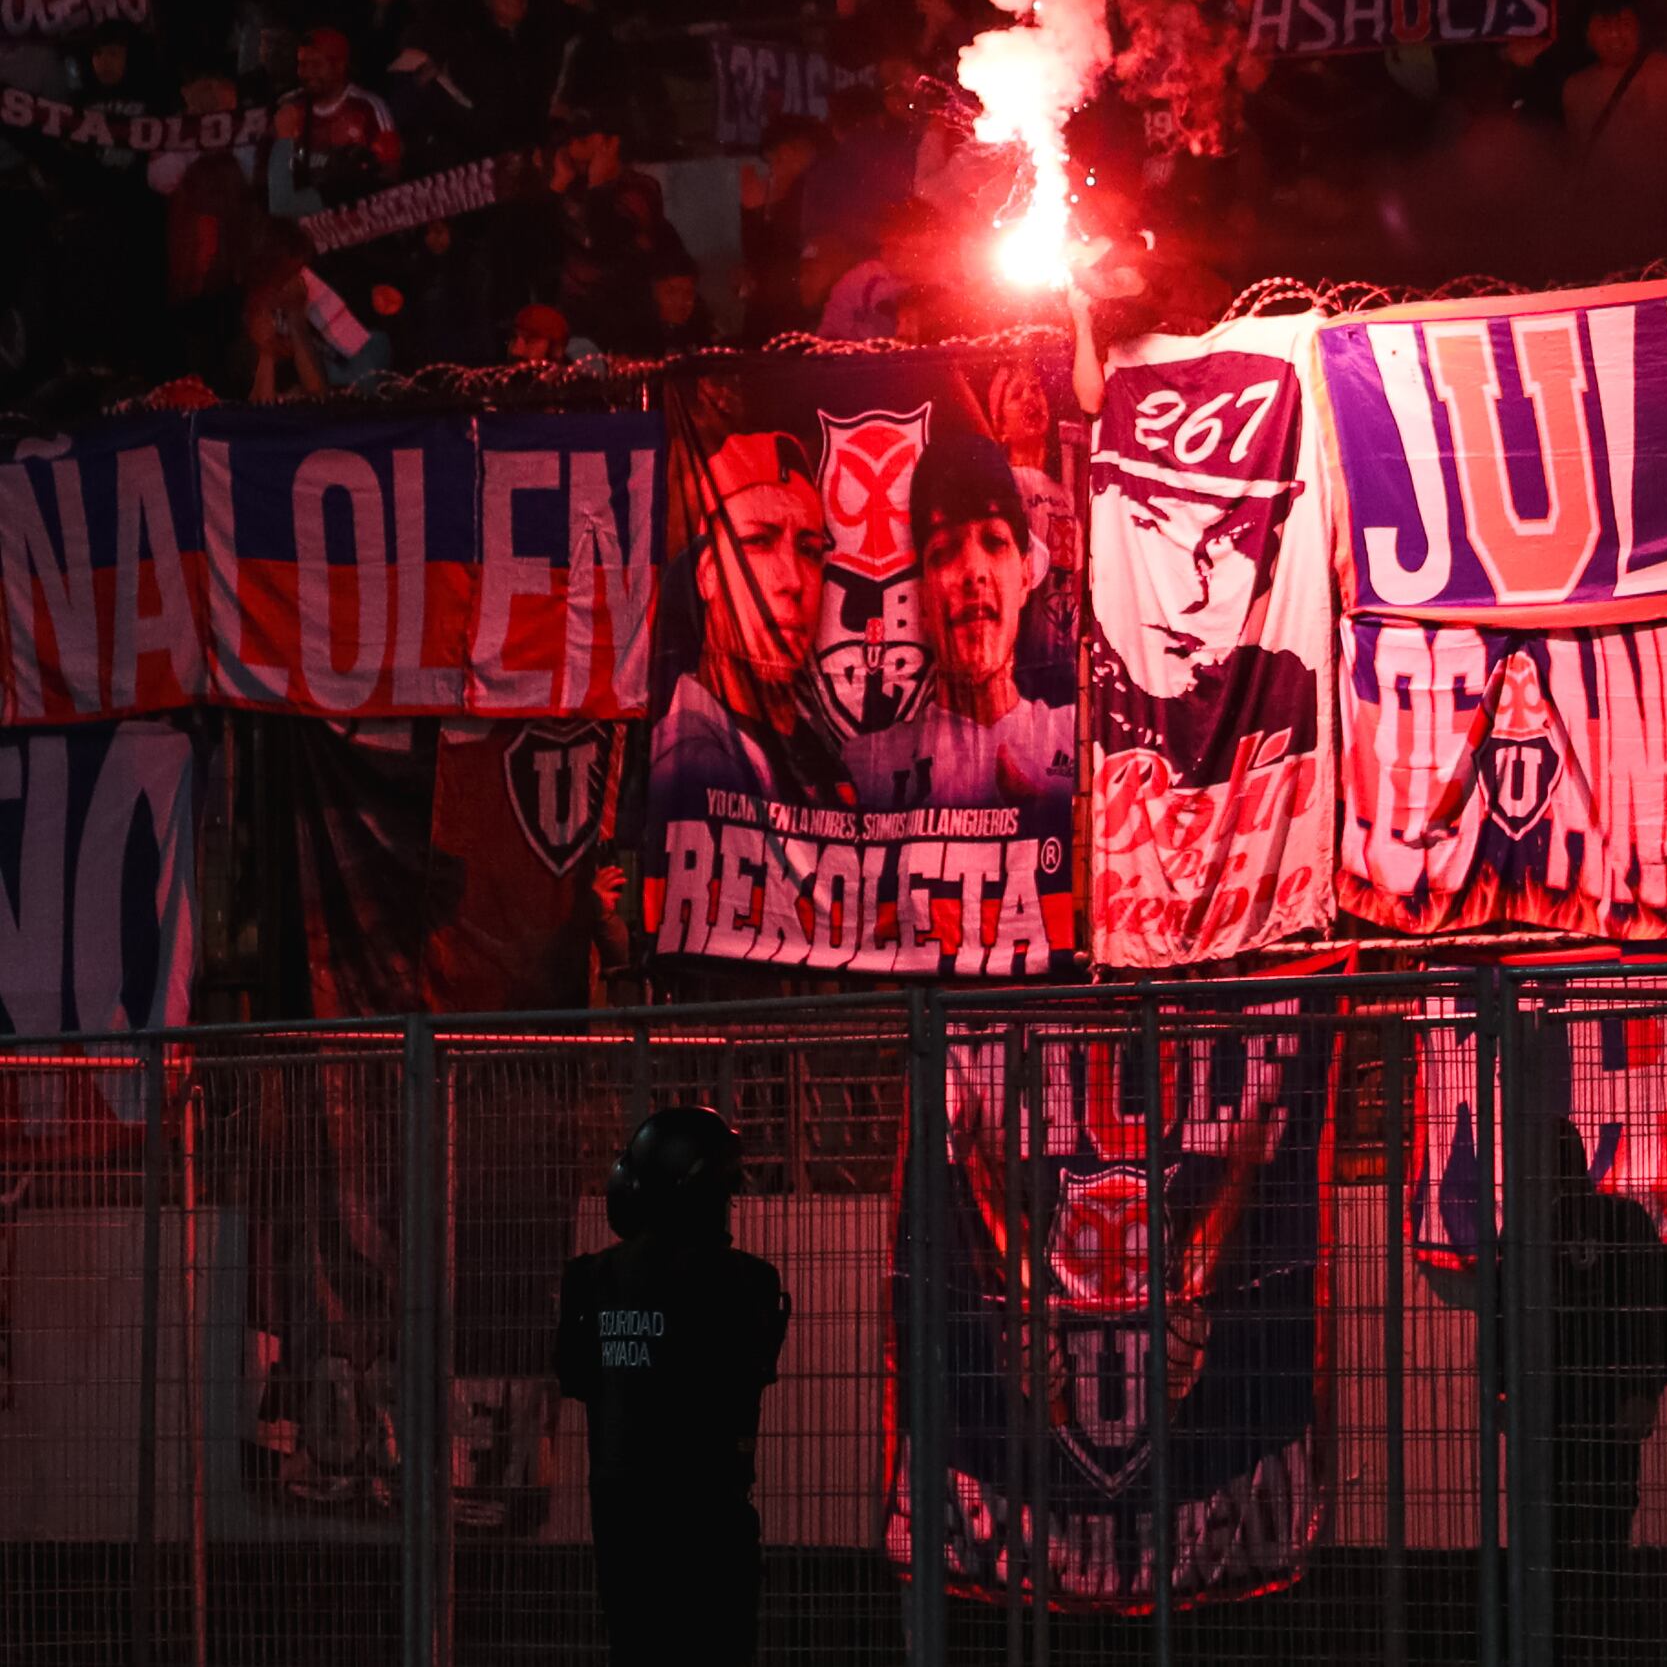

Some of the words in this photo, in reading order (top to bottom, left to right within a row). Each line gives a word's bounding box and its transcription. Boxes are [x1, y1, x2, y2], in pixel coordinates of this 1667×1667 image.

[1134, 378, 1278, 465] 267
[533, 743, 600, 845] U
[706, 787, 726, 817] YO
[863, 811, 906, 841] SOMOS
[907, 807, 1020, 838] ULLANGUEROS
